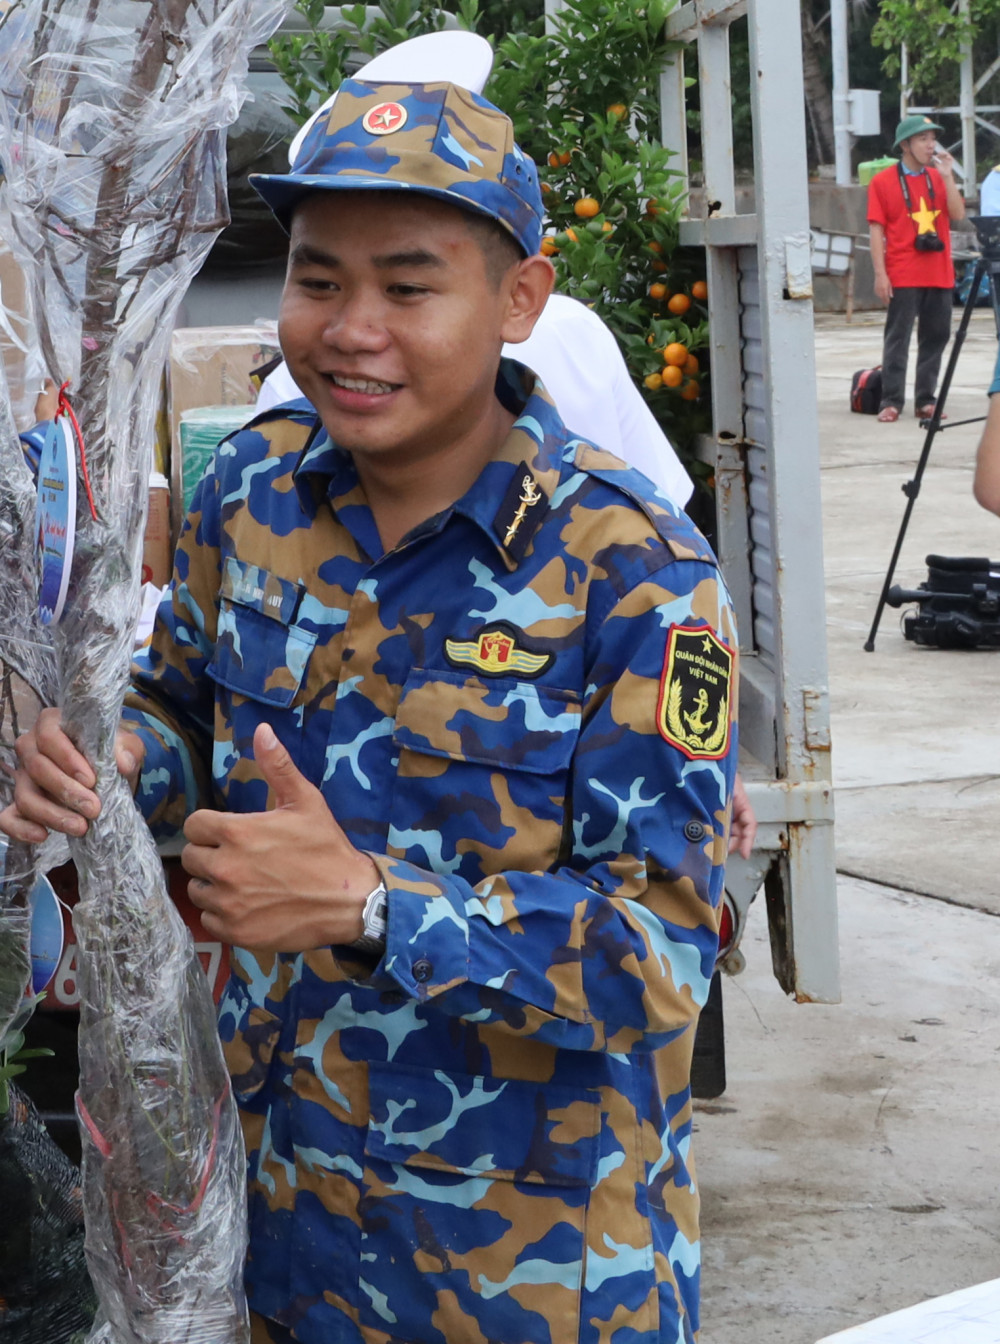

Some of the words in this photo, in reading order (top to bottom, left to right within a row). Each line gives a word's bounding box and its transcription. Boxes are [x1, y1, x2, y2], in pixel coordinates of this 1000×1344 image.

[675, 650, 695, 662] QUÂN
[689, 666, 704, 679] VIỆT
[704, 673, 718, 686] NAM
